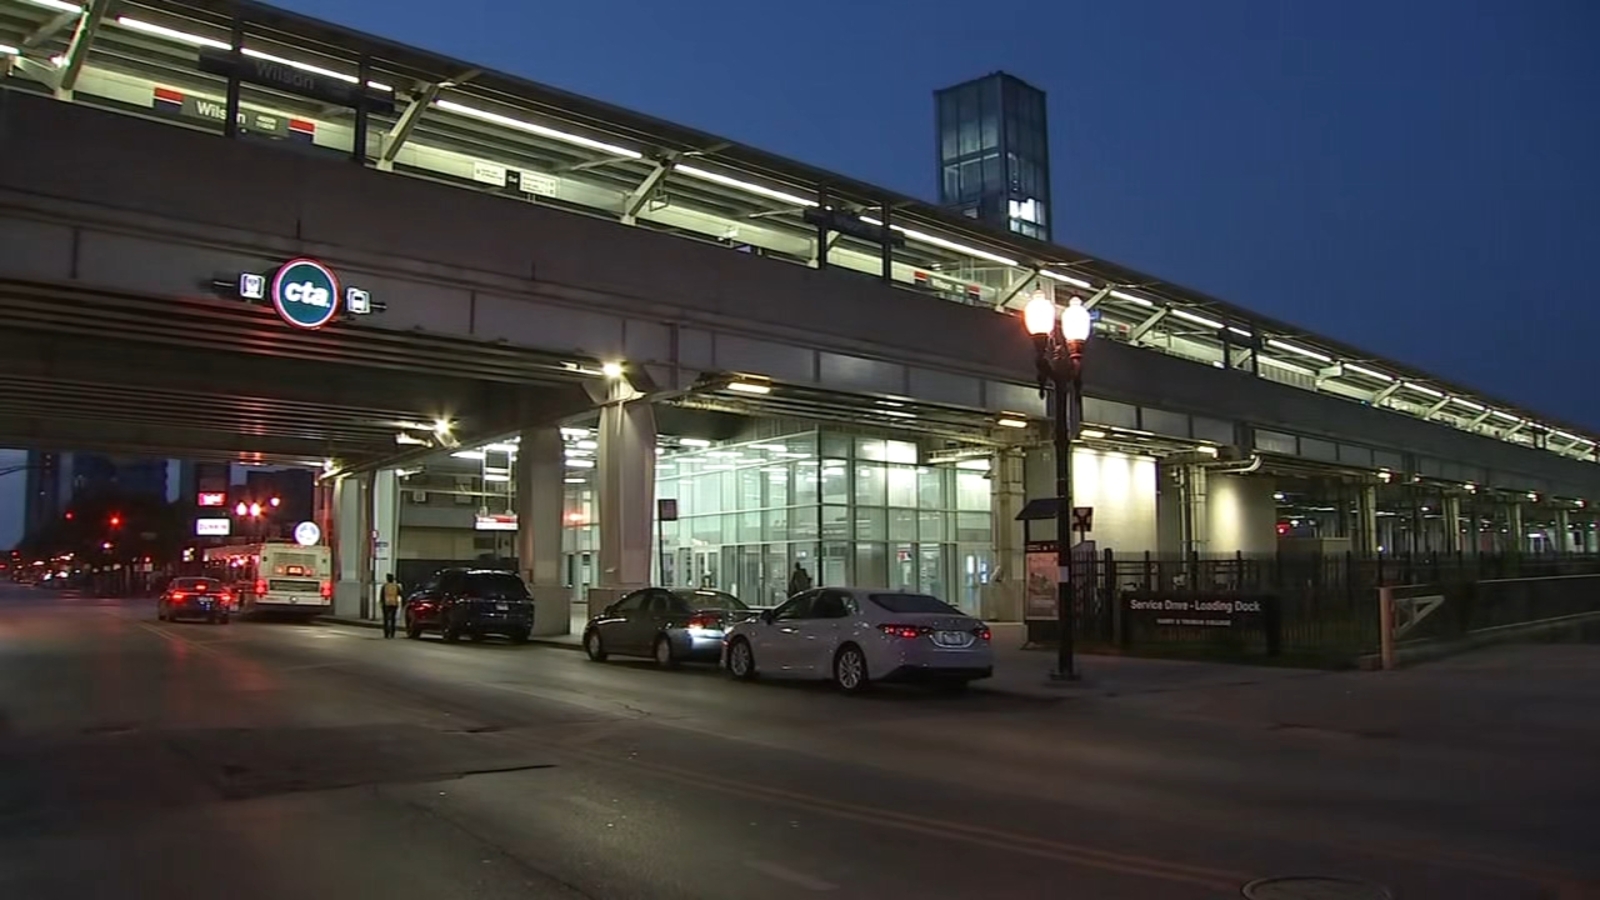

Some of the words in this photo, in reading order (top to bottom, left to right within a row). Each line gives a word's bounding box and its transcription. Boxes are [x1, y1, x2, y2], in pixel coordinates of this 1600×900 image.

[256, 61, 315, 91] Wilson
[197, 101, 246, 125] Wilsn
[1130, 599, 1163, 610] Service
[1195, 600, 1233, 613] Loading
[1234, 601, 1261, 612] Dock
